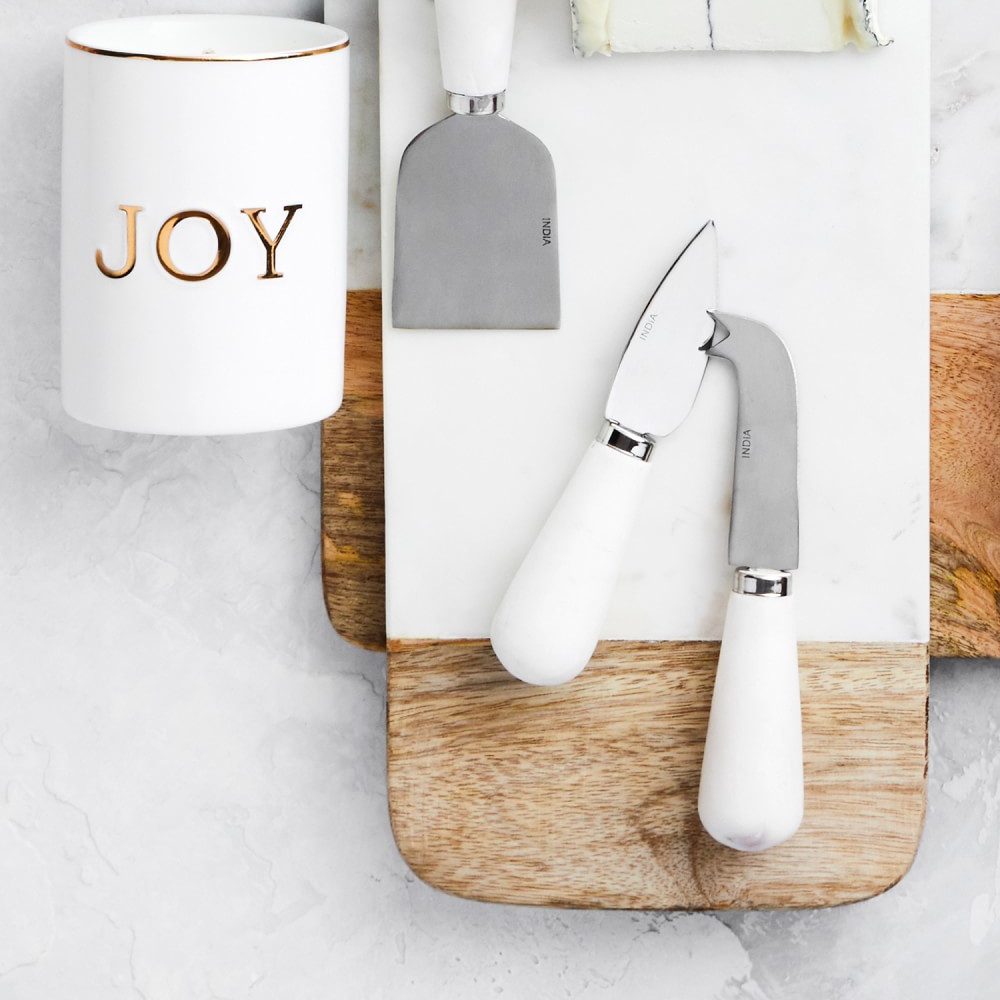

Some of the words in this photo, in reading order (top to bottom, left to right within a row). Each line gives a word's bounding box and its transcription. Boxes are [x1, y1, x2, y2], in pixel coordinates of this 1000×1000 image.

[94, 203, 303, 282] JOY
[542, 217, 552, 247] INDIA
[639, 313, 658, 342] INDIA
[741, 429, 752, 459] INDIA
